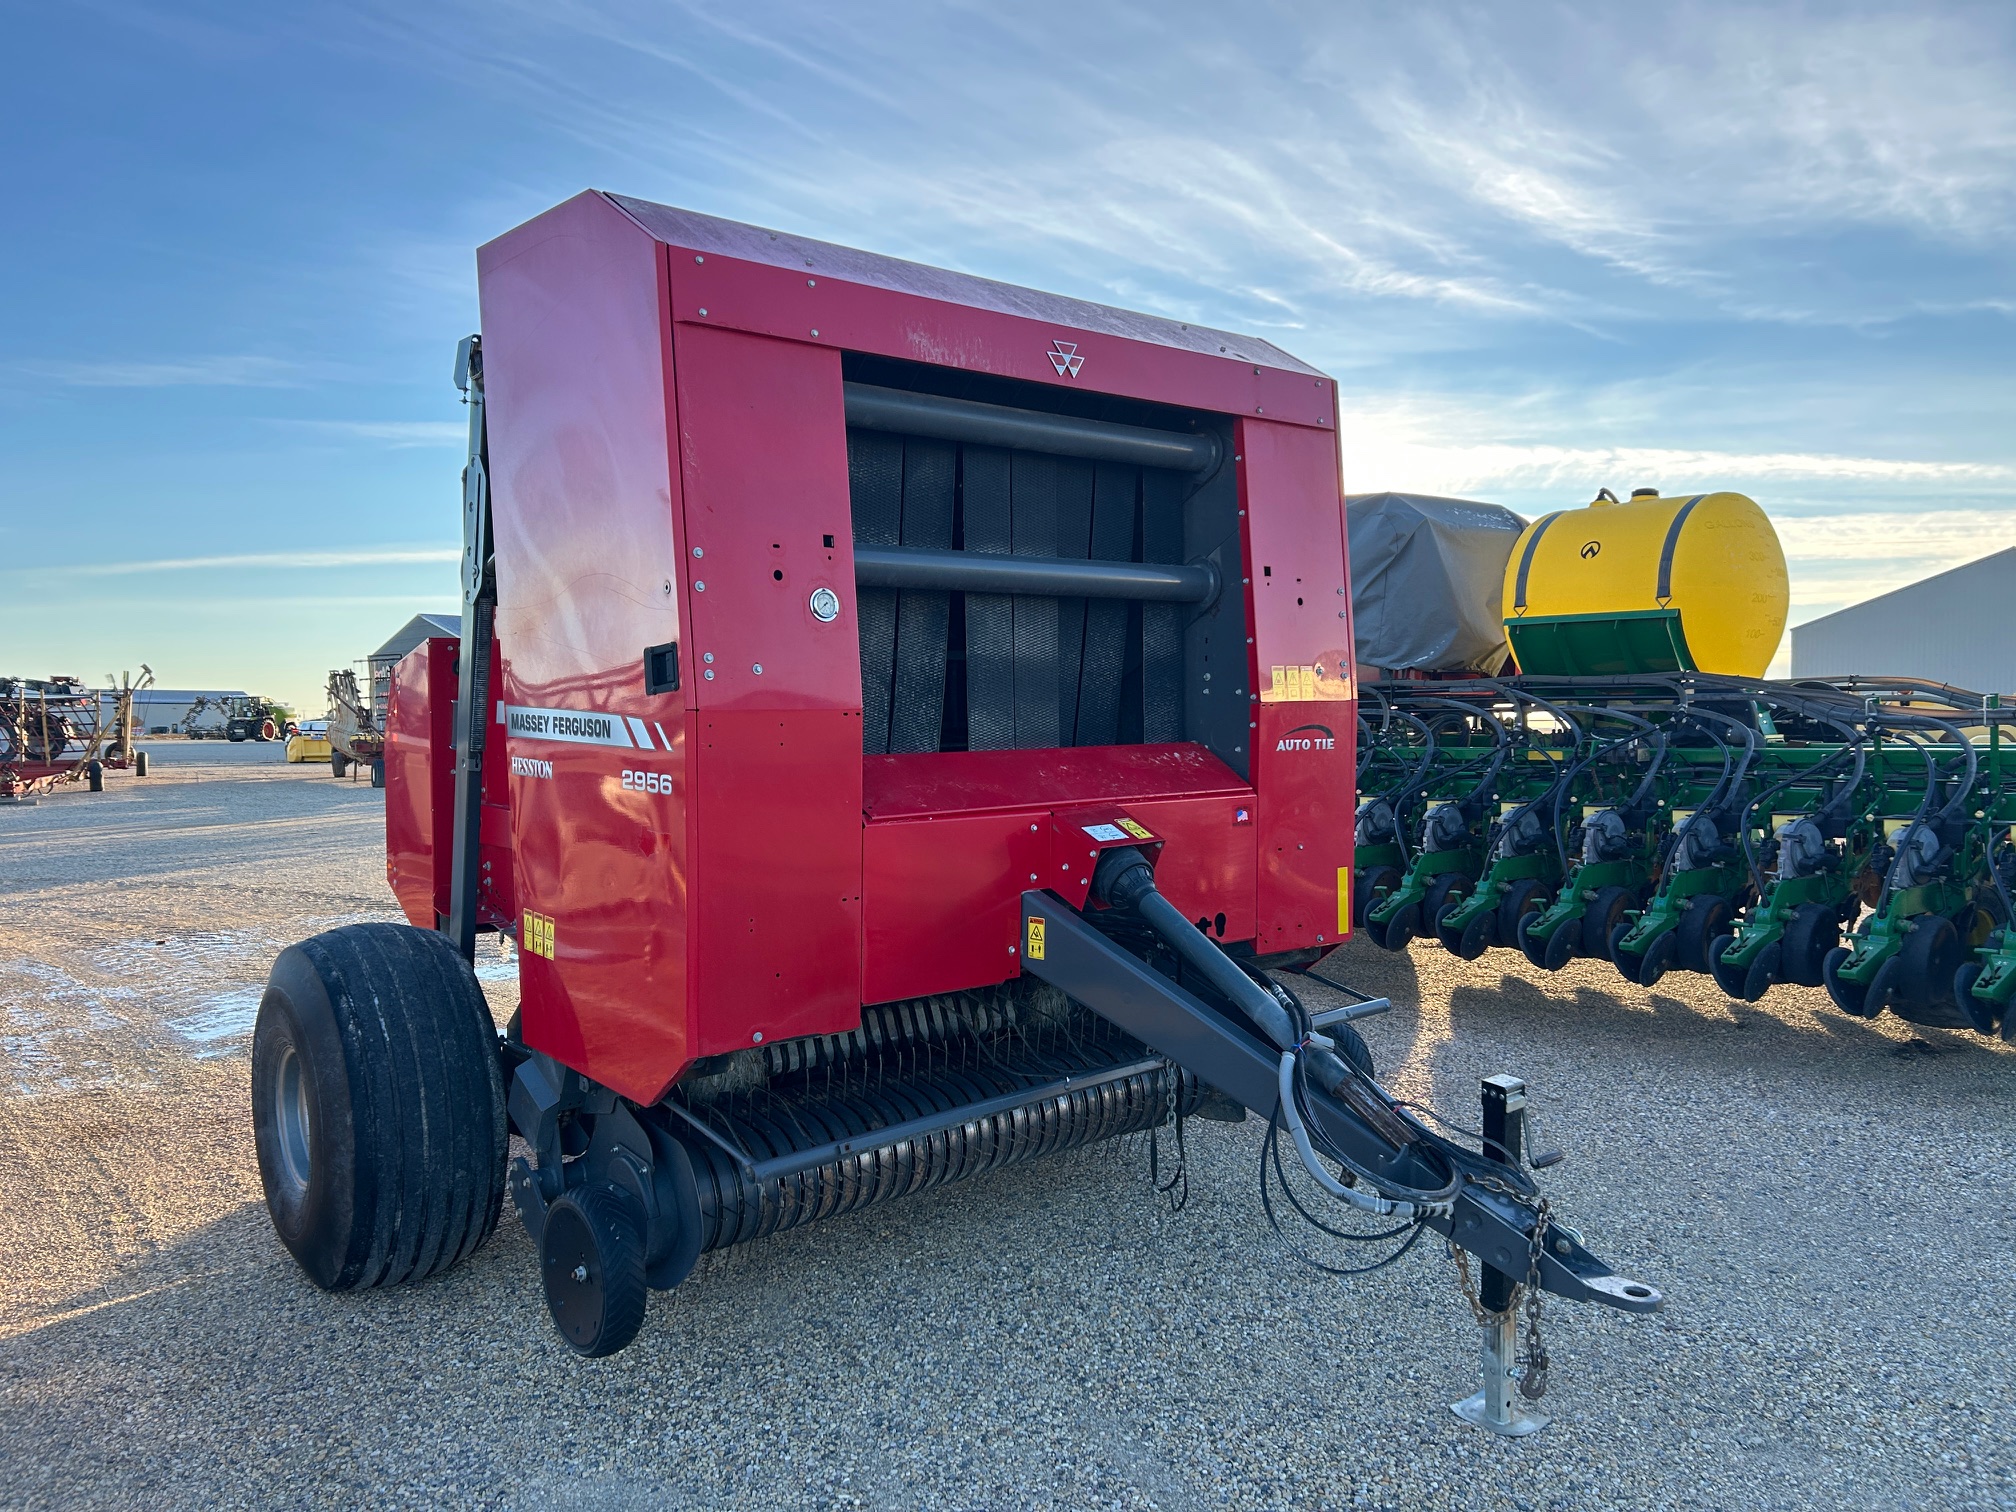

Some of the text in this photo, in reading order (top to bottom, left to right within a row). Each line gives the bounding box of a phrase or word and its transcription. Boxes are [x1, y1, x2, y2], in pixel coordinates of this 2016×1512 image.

[510, 713, 611, 739] MASSEY FERGUSON
[1276, 738, 1335, 751] AUTO TIE
[511, 756, 553, 780] HESSTON
[621, 769, 673, 795] 2956
